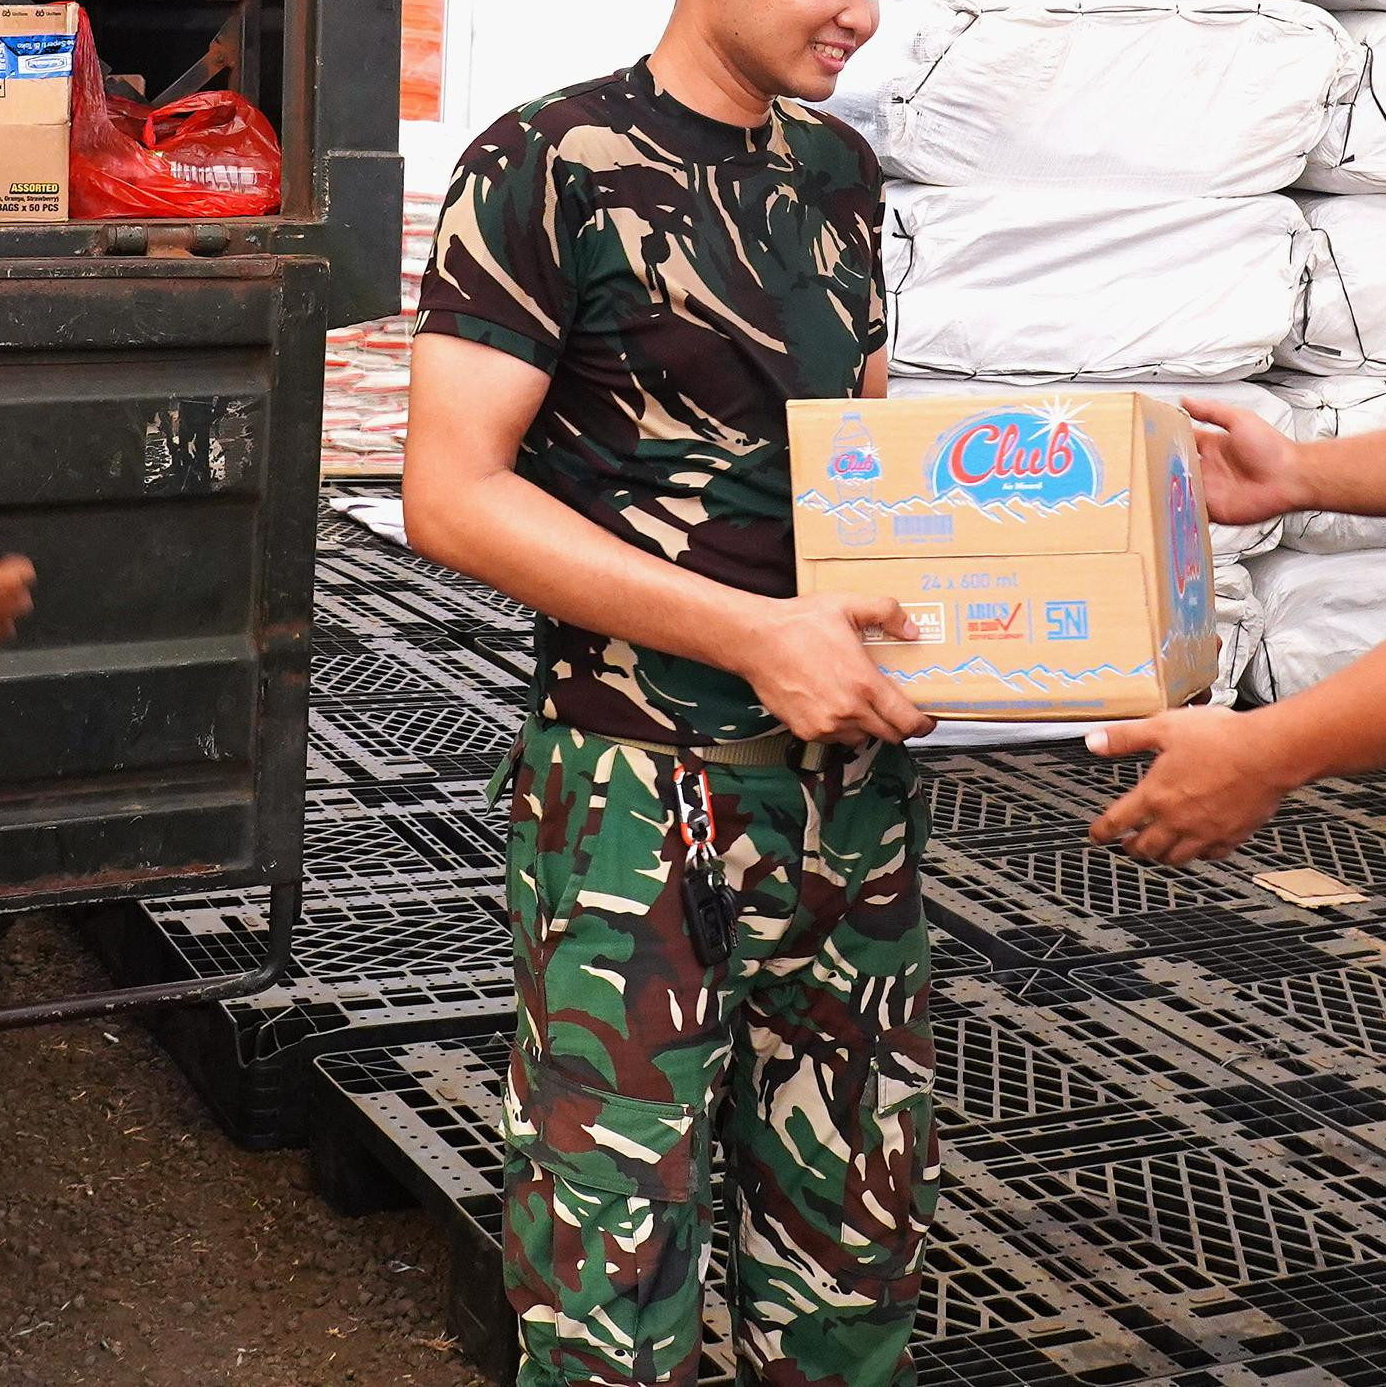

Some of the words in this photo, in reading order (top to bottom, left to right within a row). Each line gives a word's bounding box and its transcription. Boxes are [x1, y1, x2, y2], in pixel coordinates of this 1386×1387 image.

[10, 183, 59, 193] ASSORTED
[29, 203, 40, 212] 50
[42, 203, 59, 212] PCS
[949, 421, 1074, 486] Club
[834, 453, 873, 474] Club
[921, 574, 942, 590] 24
[960, 574, 990, 589] 600
[996, 572, 1018, 587] ml
[912, 613, 940, 626] LAL
[1046, 601, 1089, 641] SNI
